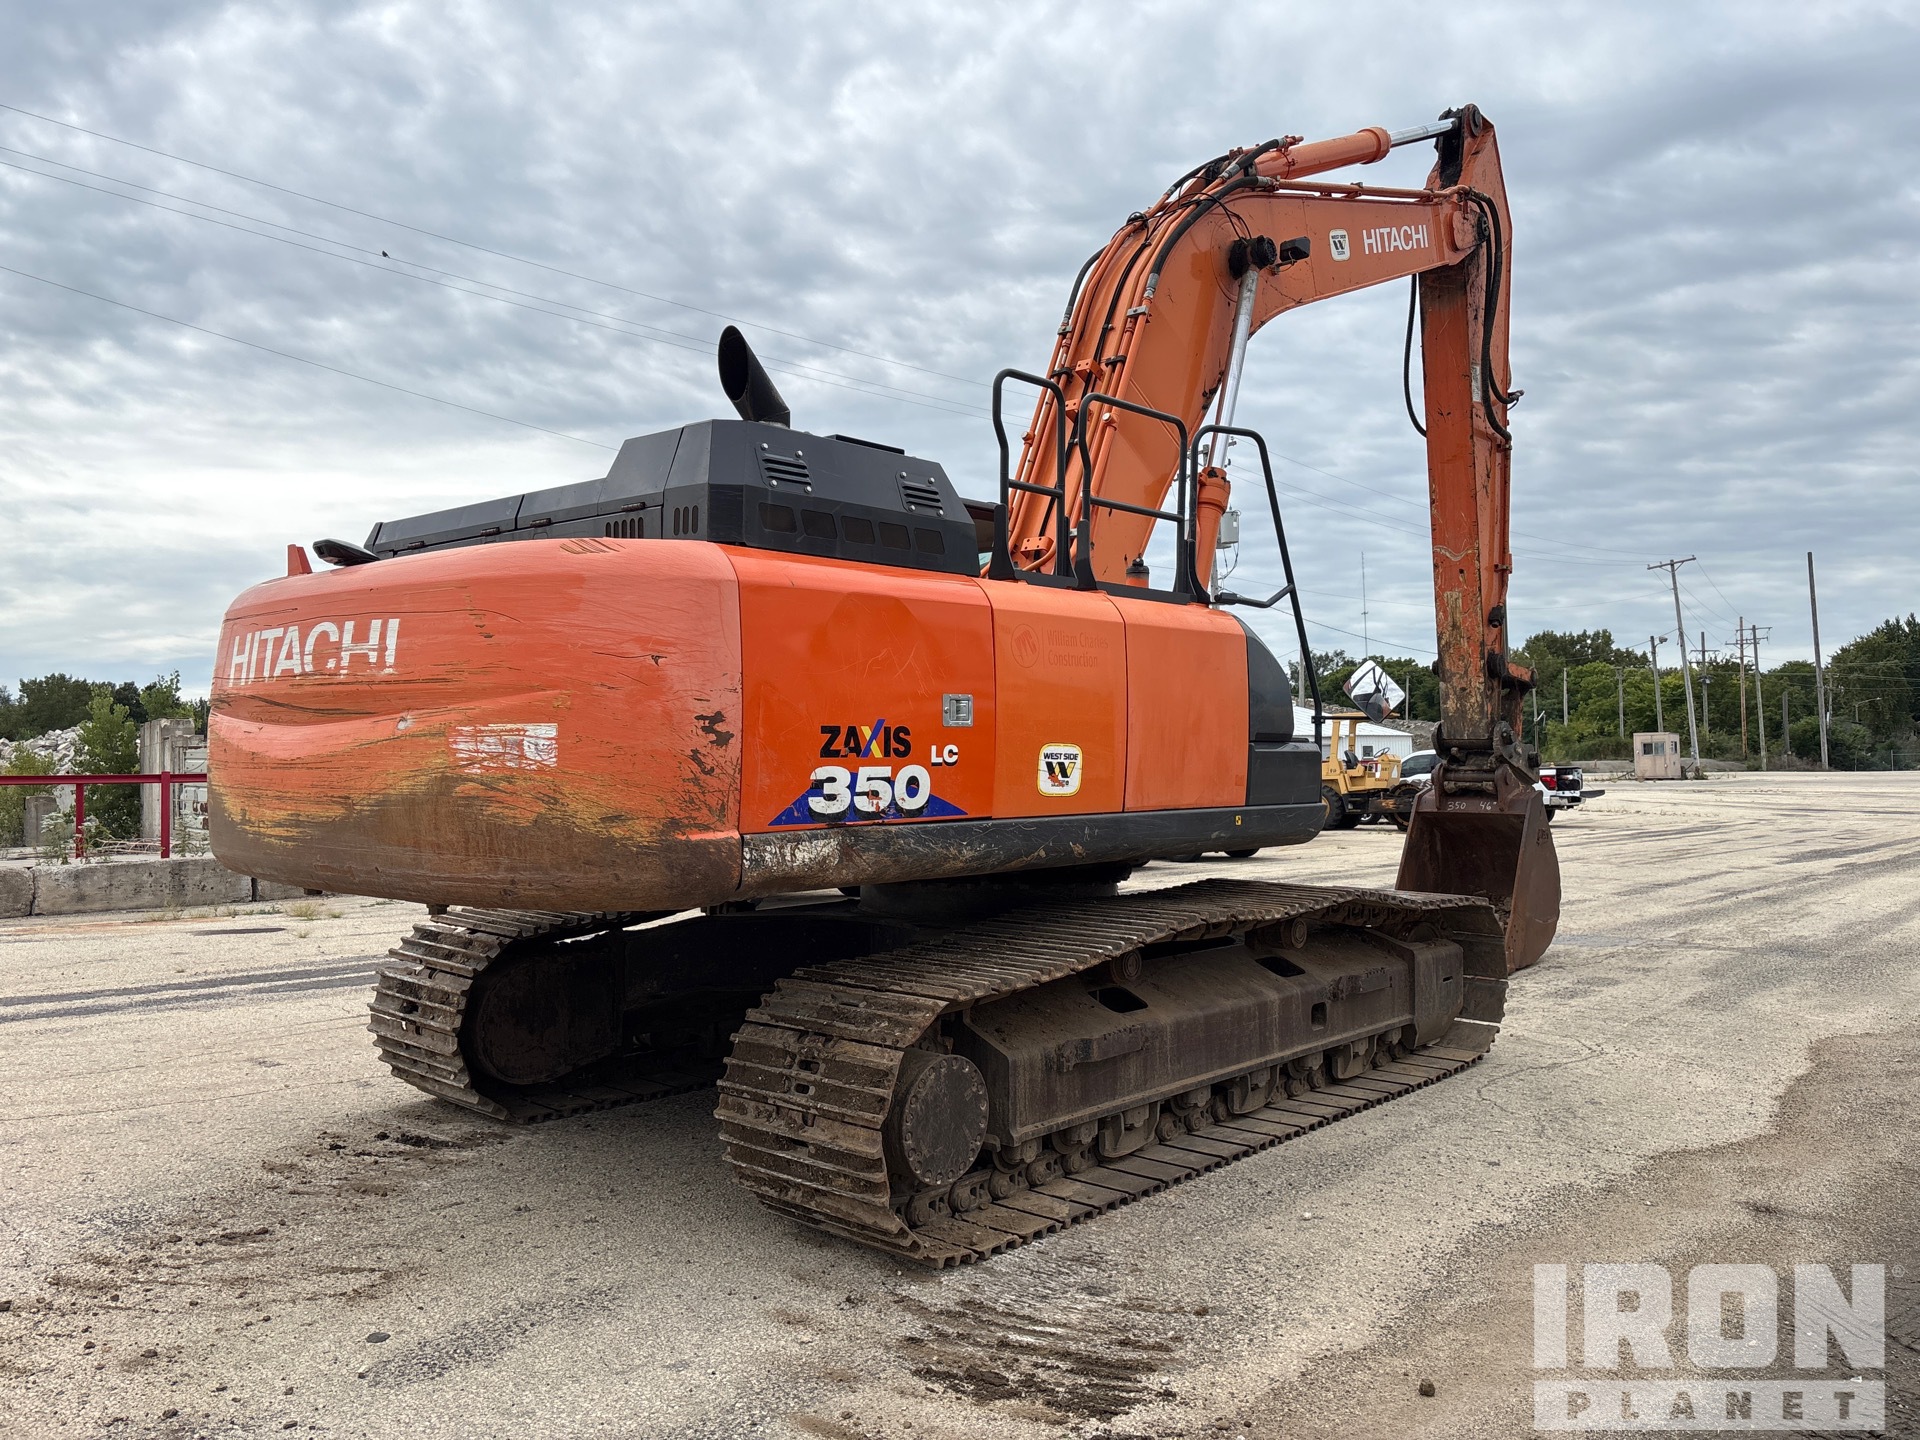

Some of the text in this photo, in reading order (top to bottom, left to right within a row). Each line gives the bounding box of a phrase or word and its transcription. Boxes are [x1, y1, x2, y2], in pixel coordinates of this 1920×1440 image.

[1362, 224, 1429, 254] HITACHI
[1047, 630, 1109, 649] William Charles
[228, 618, 400, 688] HITACHI
[1048, 650, 1098, 668] Construction
[820, 719, 911, 758] ZAXIS
[930, 744, 959, 766] LC
[1043, 752, 1079, 761] WEST SIDE
[808, 764, 931, 820] 350
[1447, 801, 1467, 811] 350
